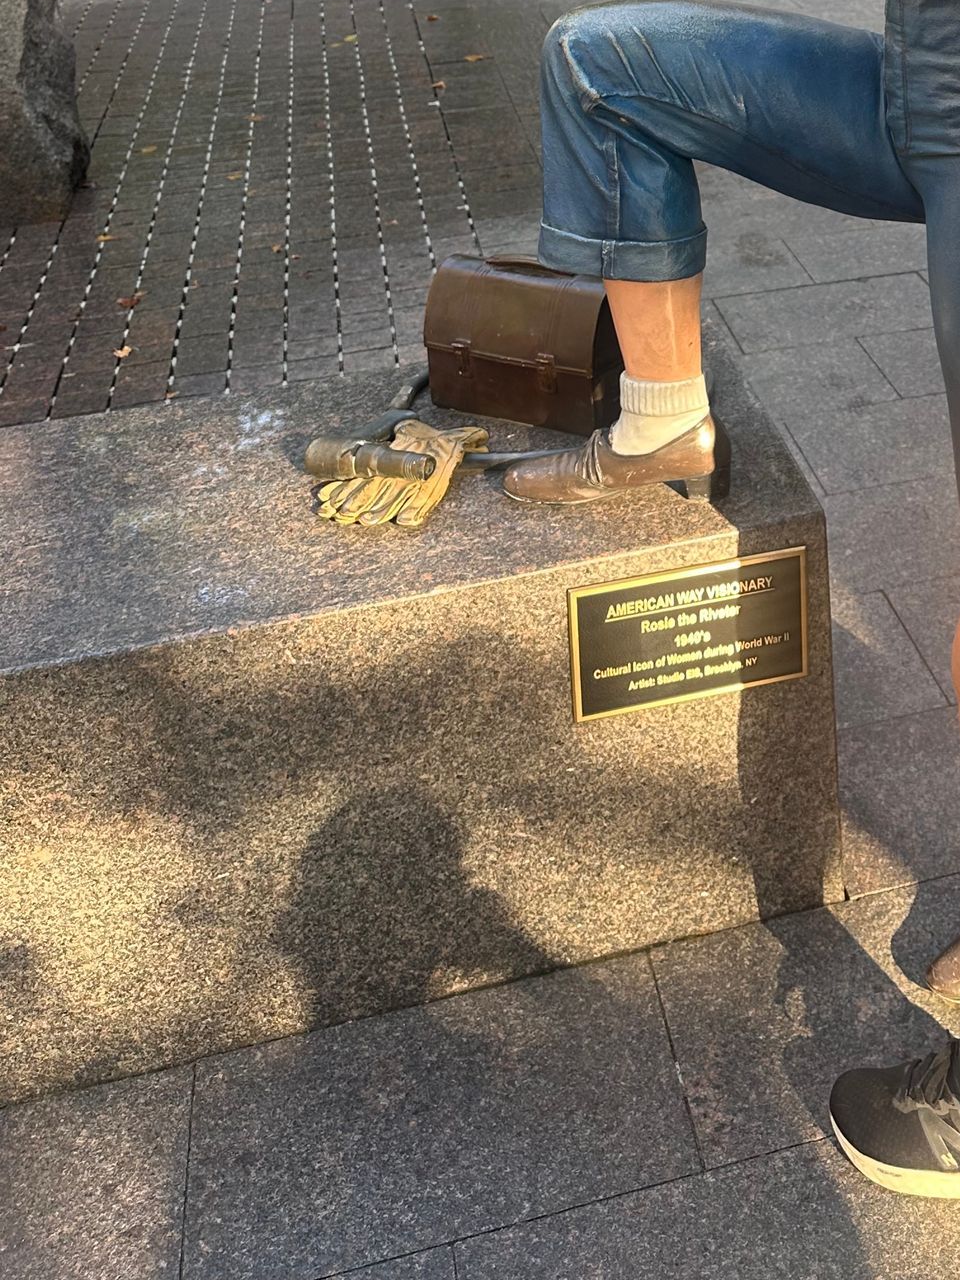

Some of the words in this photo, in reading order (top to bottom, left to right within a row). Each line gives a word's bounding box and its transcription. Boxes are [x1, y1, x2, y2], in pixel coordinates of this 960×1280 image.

[606, 593, 675, 619] AMERICAN
[676, 587, 705, 606] WAY
[705, 576, 773, 601] VISIONARY
[640, 616, 676, 634] Rosie
[677, 612, 697, 627] the
[699, 604, 741, 624] Riveter
[593, 662, 632, 680] Cultural
[632, 659, 654, 673] Icon
[655, 655, 666, 668] of
[667, 650, 702, 666] Women
[703, 643, 735, 659] during
[734, 636, 762, 653] World
[764, 635, 782, 645] War
[783, 632, 790, 641] II
[673, 629, 712, 648] 1940's
[628, 676, 656, 691] Artist:
[656, 671, 685, 686] Studio
[745, 656, 758, 667] NY
